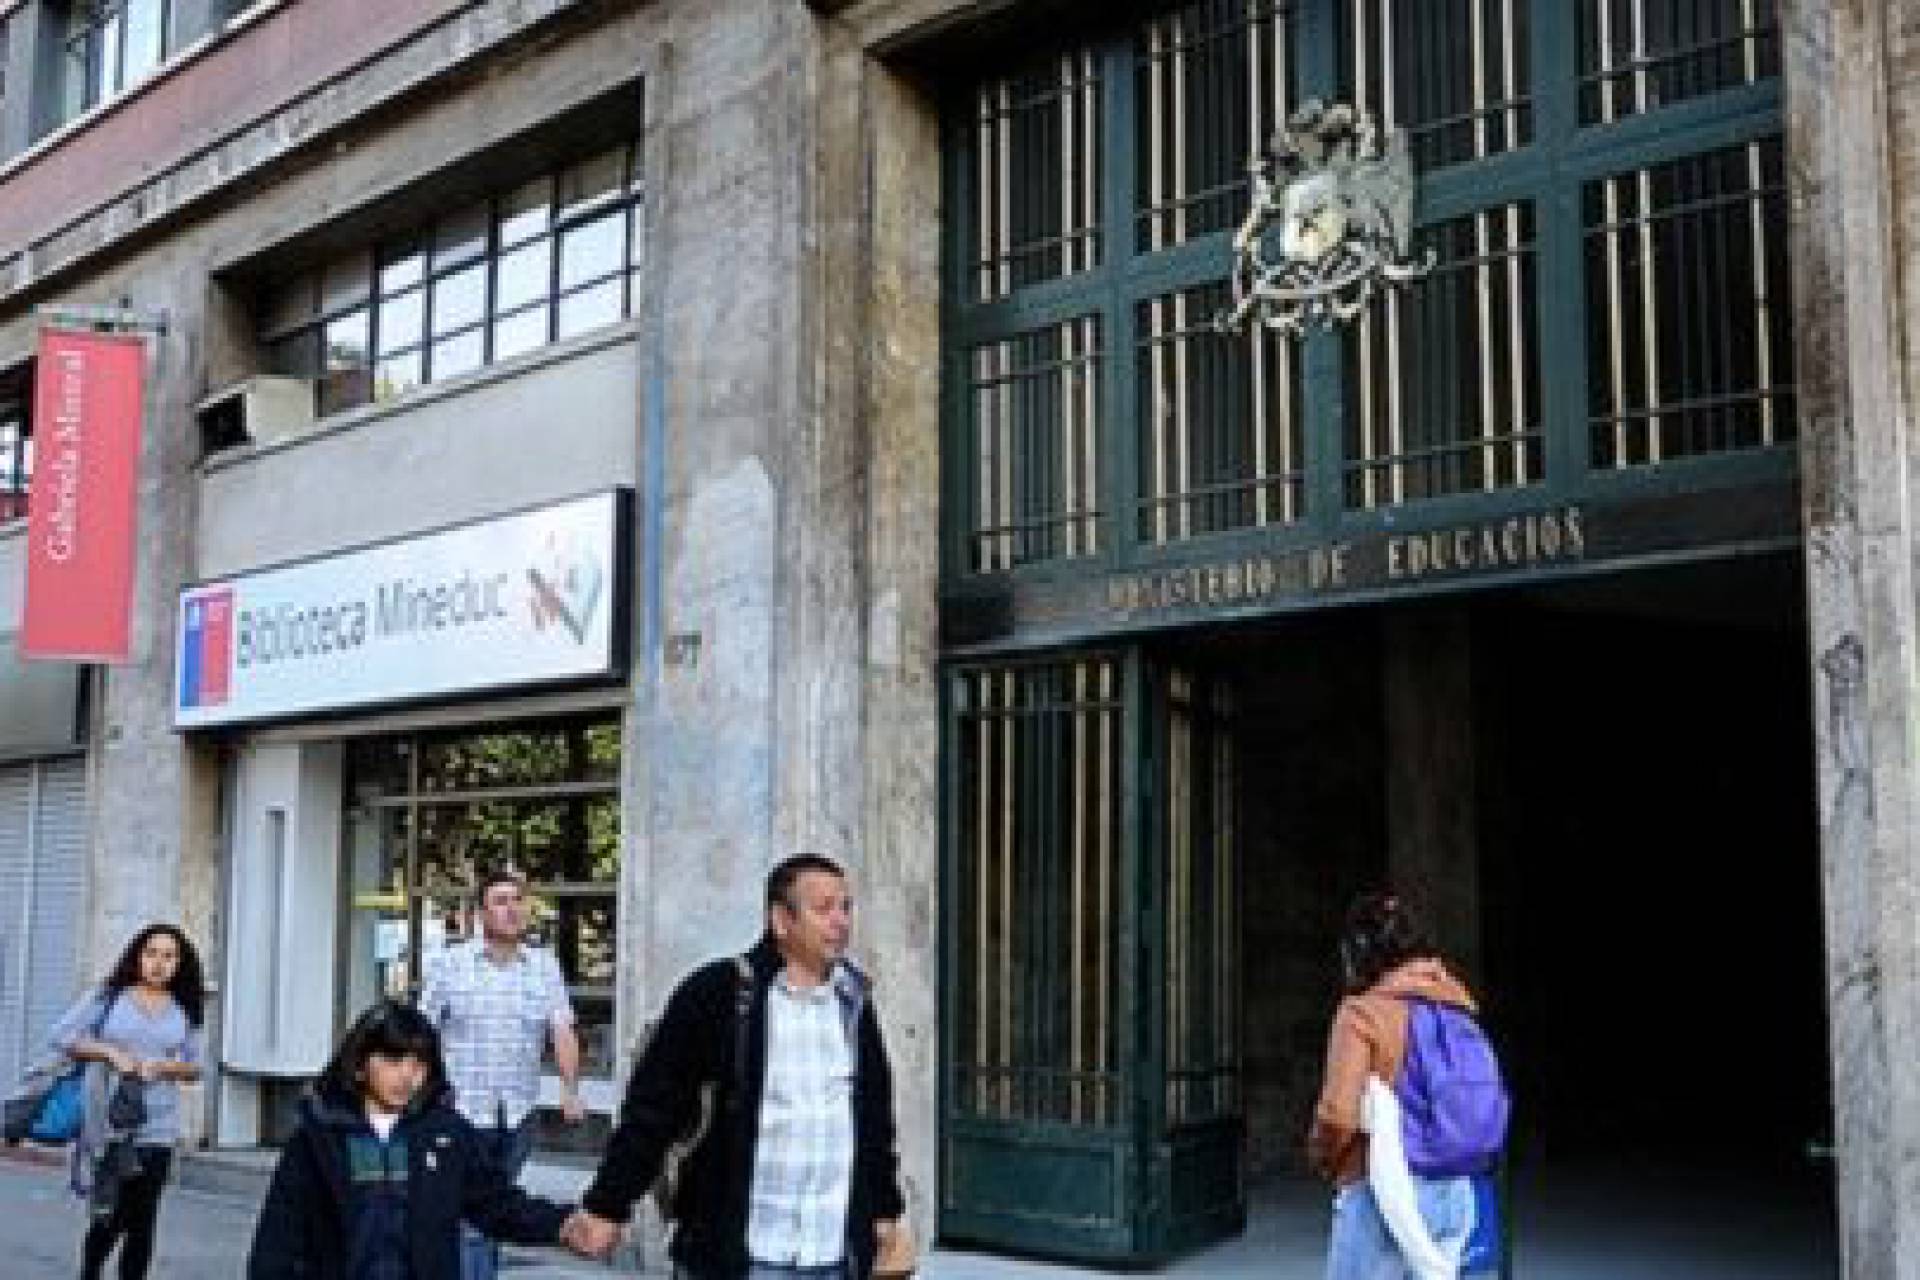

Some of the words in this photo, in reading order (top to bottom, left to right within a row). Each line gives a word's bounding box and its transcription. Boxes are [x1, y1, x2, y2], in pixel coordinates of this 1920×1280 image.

[54, 350, 84, 443] Mistral
[46, 452, 78, 561] Gabriela
[1307, 540, 1350, 588] DE
[237, 600, 366, 669] Biblioteca
[374, 568, 508, 636] Mineduc
